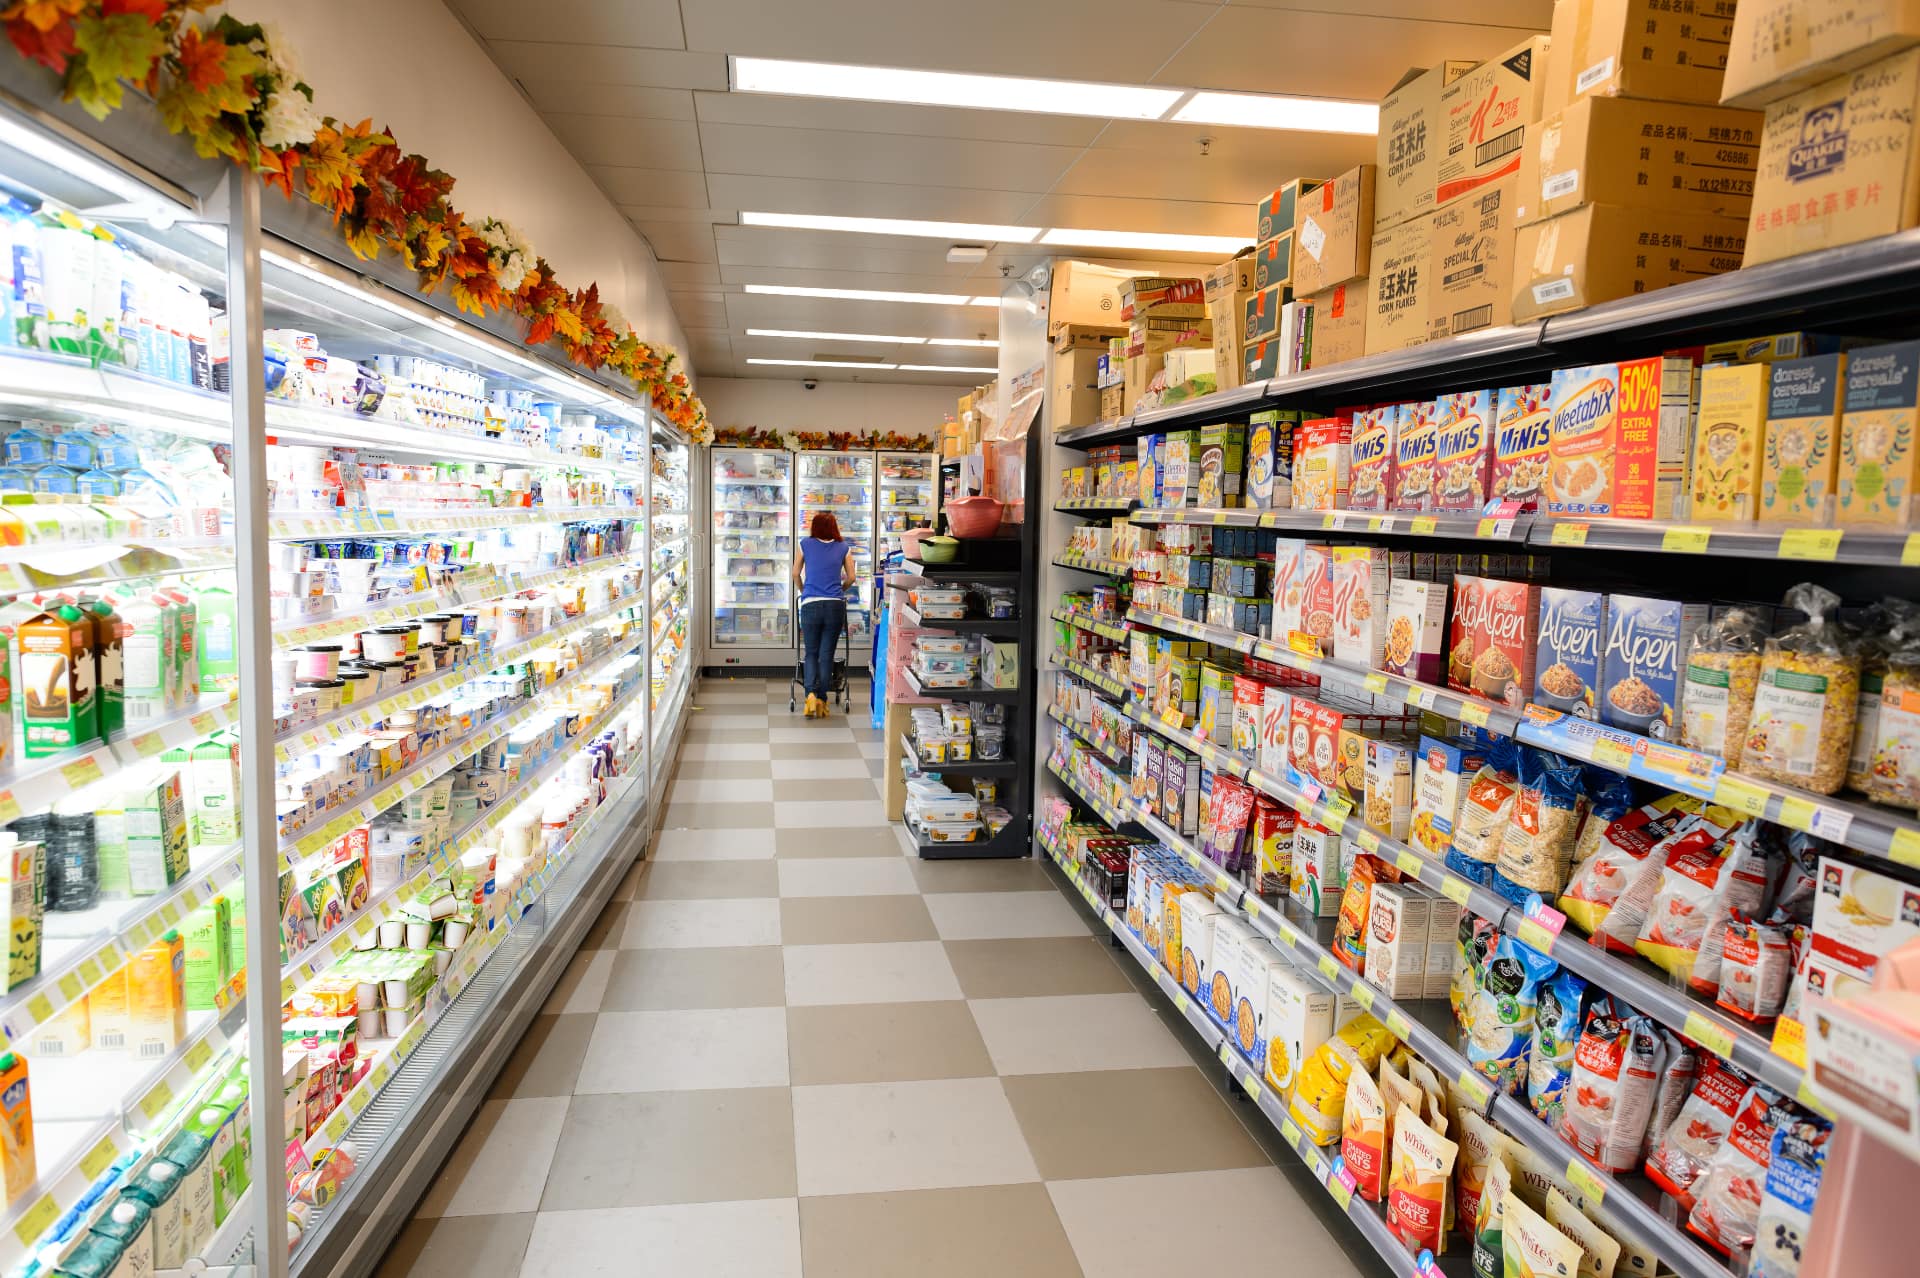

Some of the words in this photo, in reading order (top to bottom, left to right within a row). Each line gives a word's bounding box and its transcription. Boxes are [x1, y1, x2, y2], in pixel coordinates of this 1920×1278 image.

[1469, 84, 1499, 144] K
[1405, 152, 1426, 167] FLAKES
[1791, 138, 1845, 167] QUAKER
[1443, 251, 1470, 270] SPECIAL
[1470, 237, 1484, 263] K
[1241, 274, 1248, 287] 3
[1386, 265, 1418, 301] 玉米片
[1378, 301, 1394, 314] CORN
[1396, 296, 1417, 311] FLAKES
[1774, 366, 1816, 384] dorset
[1851, 355, 1897, 374] dorset
[1620, 363, 1658, 413] 50%
[1773, 380, 1821, 398] cereals
[1554, 388, 1616, 435] Weetabix
[1621, 416, 1652, 430] EXTRA
[1624, 430, 1648, 443] FREE
[1275, 553, 1299, 612] K
[1335, 573, 1358, 630] K
[1475, 591, 1525, 649] Alpen
[1537, 604, 1598, 664] Alpen
[1605, 610, 1678, 679] Alpen
[1264, 704, 1284, 748] K
[1346, 1148, 1371, 1170] OATS
[1398, 1199, 1429, 1225] OATS
[1399, 1191, 1430, 1215] TOASTED
